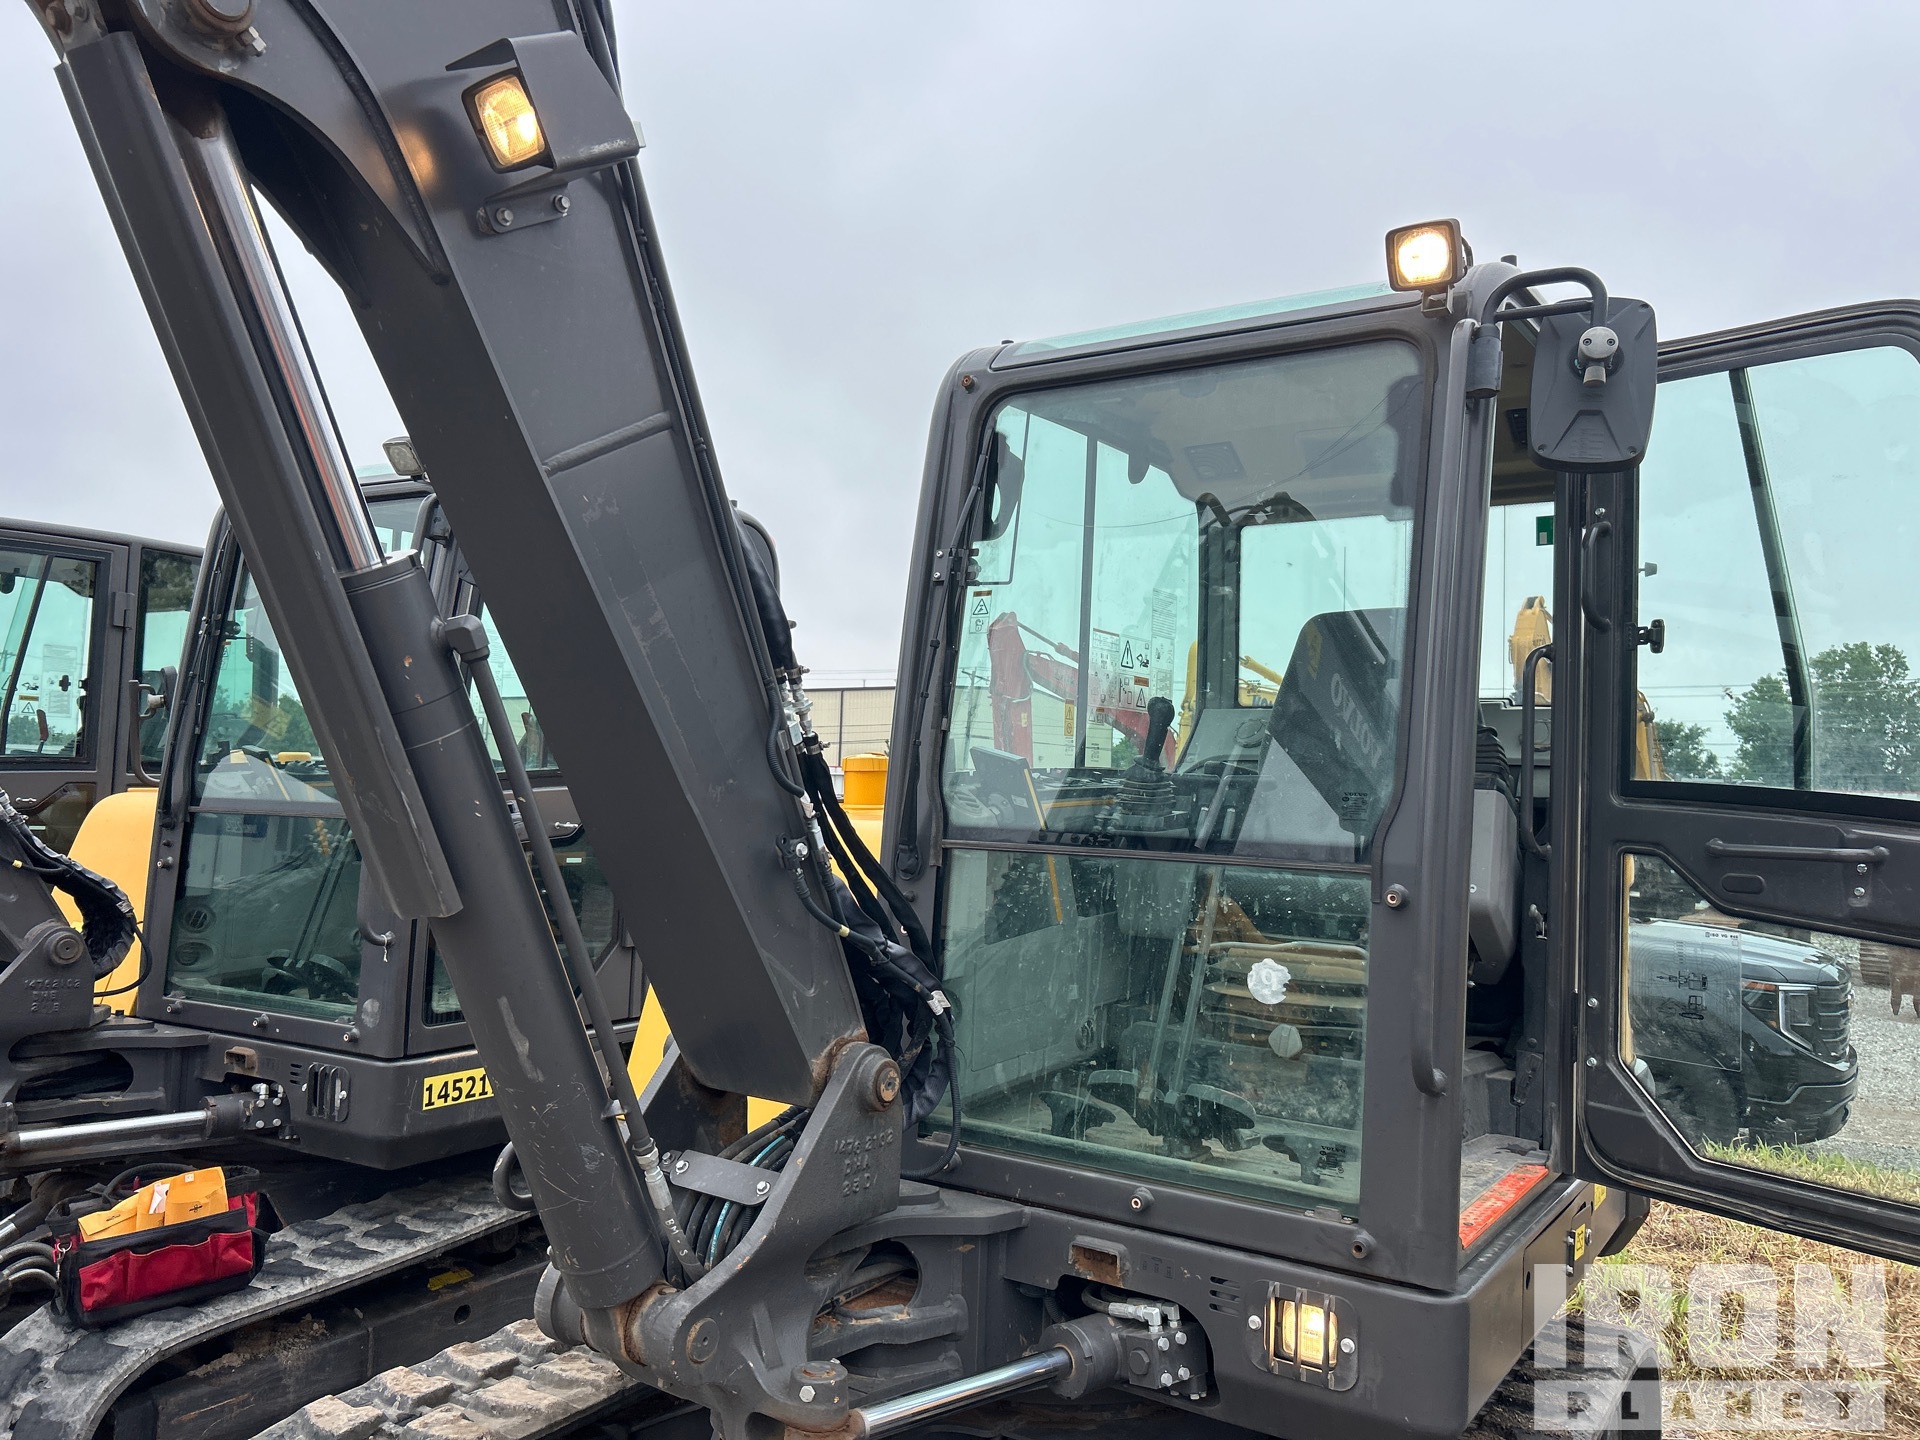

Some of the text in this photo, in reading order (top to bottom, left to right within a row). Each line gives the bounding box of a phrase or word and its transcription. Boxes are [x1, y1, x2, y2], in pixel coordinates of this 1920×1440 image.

[1331, 673, 1382, 769] VOLVO
[424, 1073, 488, 1107] 14521
[1321, 1145, 1346, 1153] VOLVO
